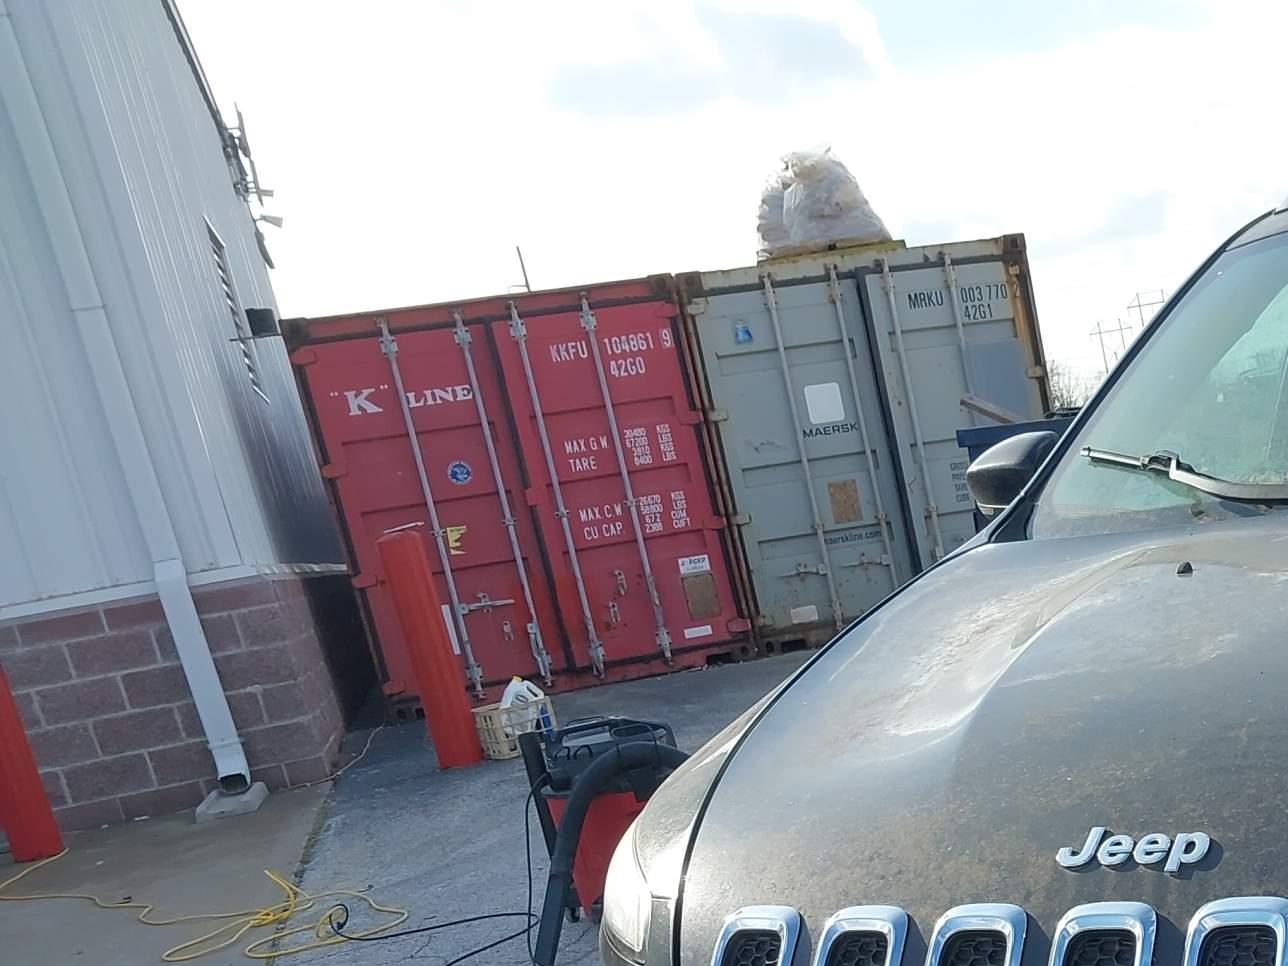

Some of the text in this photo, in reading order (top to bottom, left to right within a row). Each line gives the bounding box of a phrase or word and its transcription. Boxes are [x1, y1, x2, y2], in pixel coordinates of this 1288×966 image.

[907, 290, 944, 309] MRKU
[960, 286, 983, 303] 003
[986, 283, 1008, 301] 770
[964, 303, 993, 320] 42G1
[549, 329, 673, 362] KKFU 104861 9
[406, 384, 473, 408] LINE
[656, 424, 670, 434] KGS
[802, 422, 858, 438] MAERSK
[658, 433, 673, 443] LBS
[632, 442, 674, 457] 3810 KGS
[662, 451, 677, 461] LBS
[569, 456, 598, 473] TARE
[671, 491, 685, 502] KGS
[673, 500, 687, 510] LBS
[583, 526, 599, 540] CU
[1055, 826, 1211, 873] Jeep
